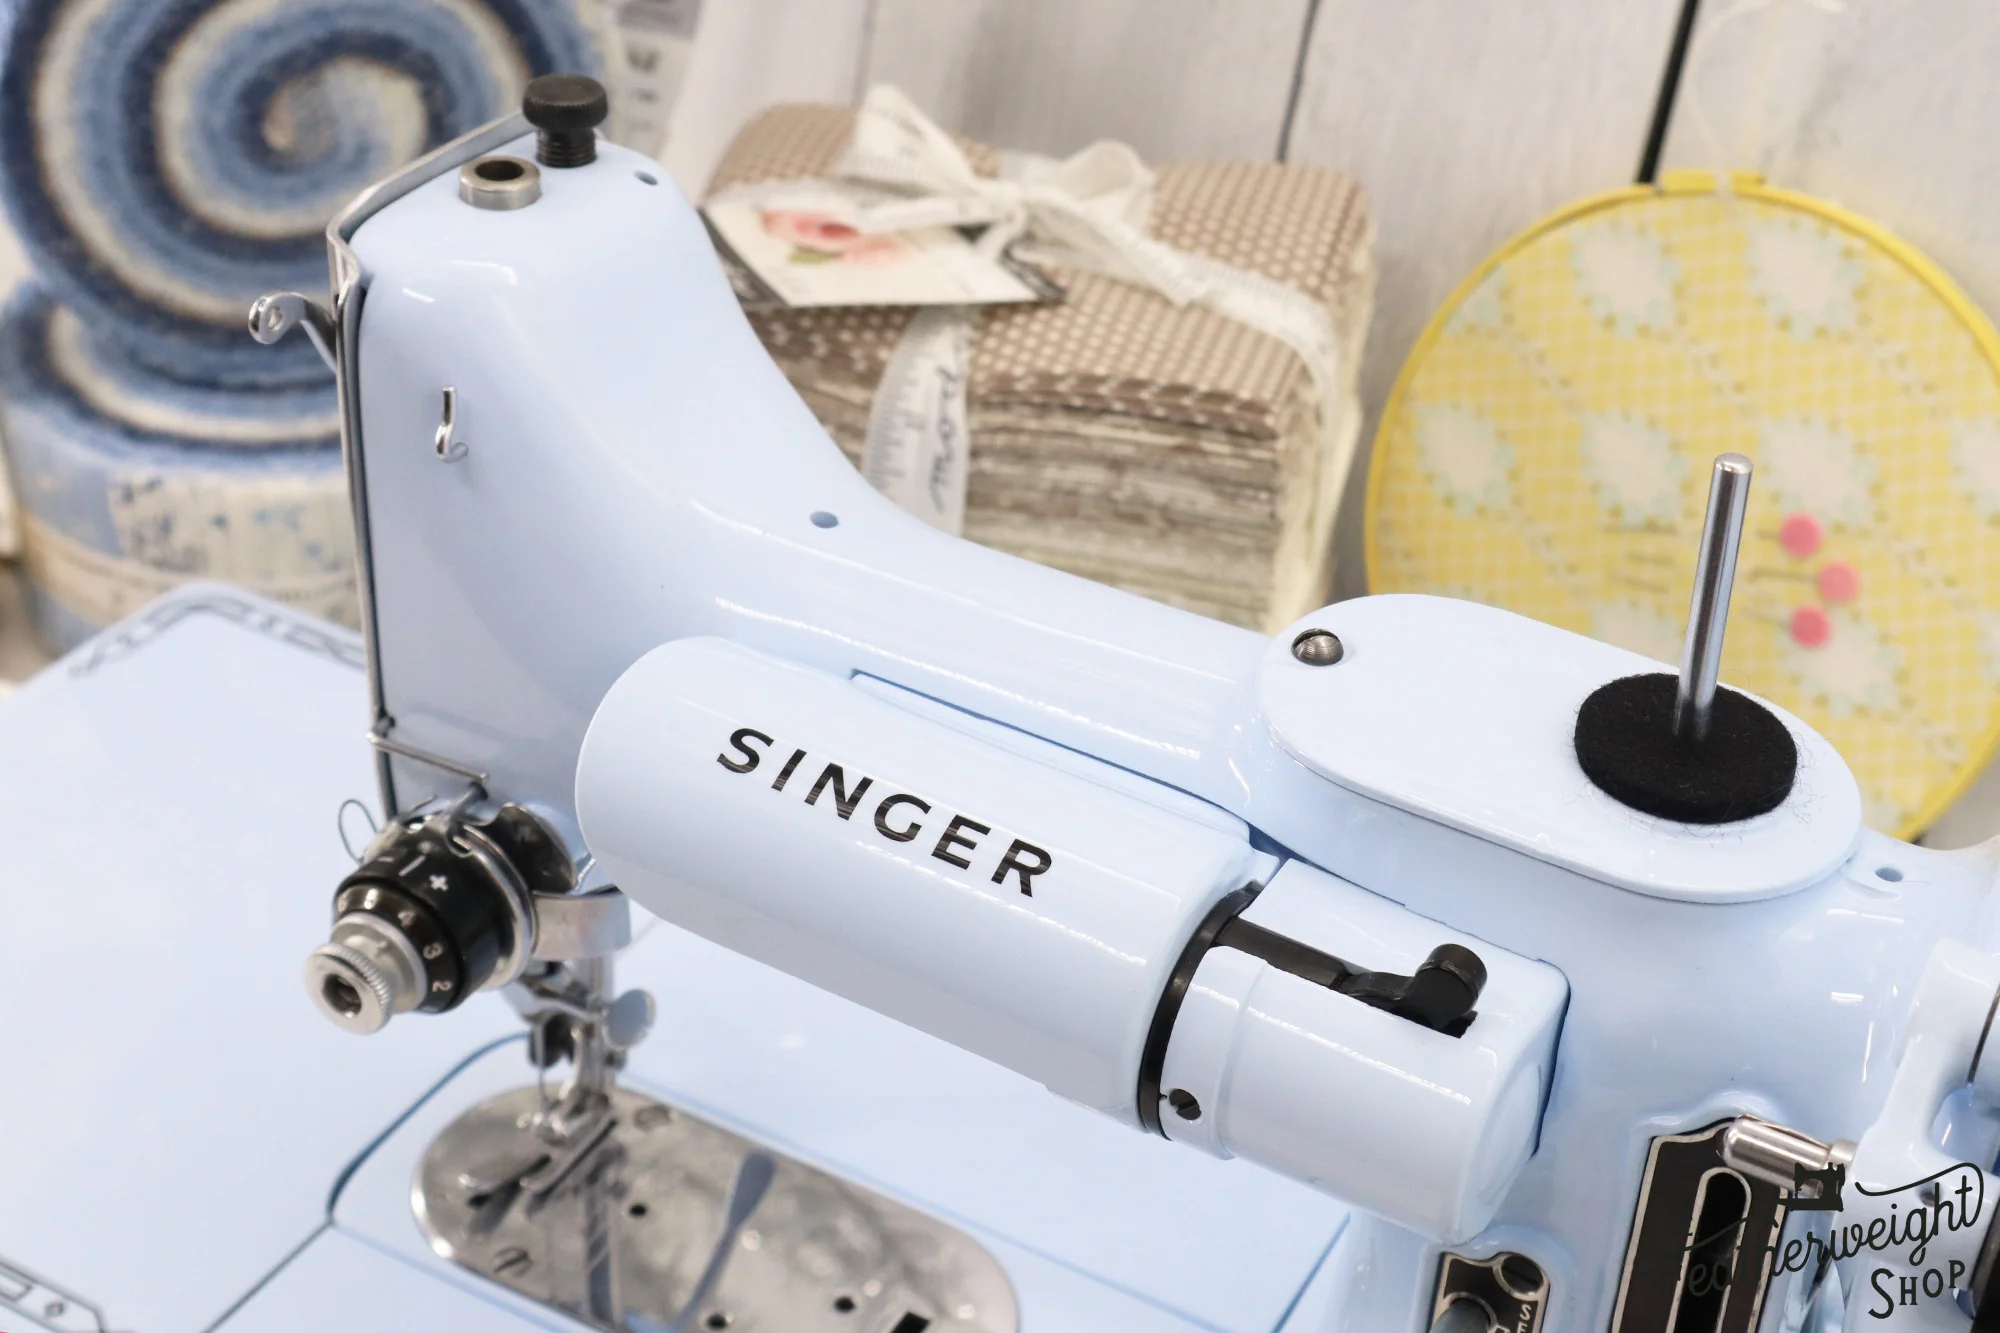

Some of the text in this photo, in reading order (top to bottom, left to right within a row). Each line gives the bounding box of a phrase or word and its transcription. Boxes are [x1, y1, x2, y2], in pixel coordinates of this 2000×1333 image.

[716, 727, 1052, 898] SINGER
[423, 941, 444, 960] 3
[432, 980, 452, 993] 2
